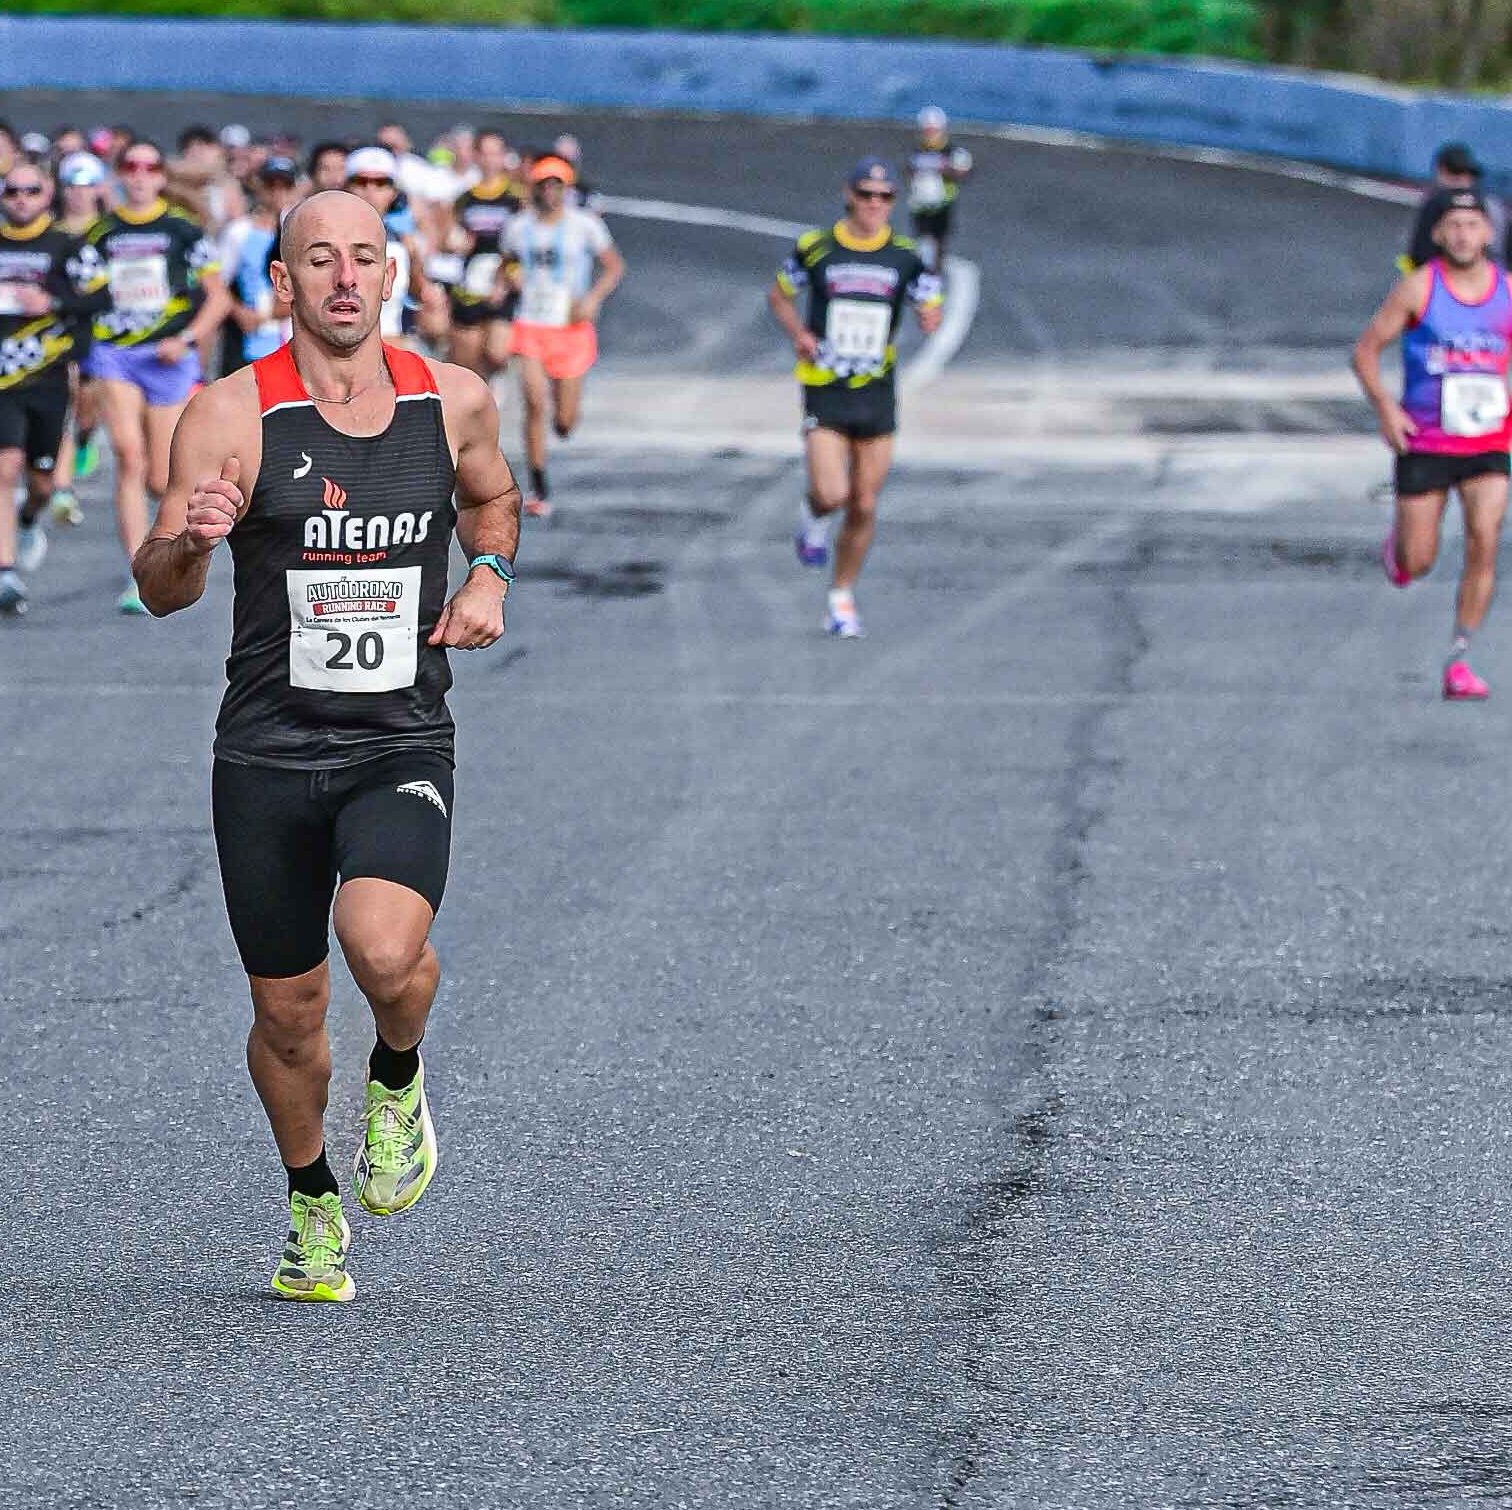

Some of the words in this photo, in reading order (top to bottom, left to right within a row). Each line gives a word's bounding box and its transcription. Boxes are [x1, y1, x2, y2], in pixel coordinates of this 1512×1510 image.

[304, 509, 433, 550] ATENAS
[302, 551, 352, 565] running
[356, 550, 386, 563] team
[307, 576, 403, 602] AUTÓDROMO
[322, 601, 362, 614] RUNNING
[364, 601, 388, 612] RACE
[325, 631, 384, 671] 20
